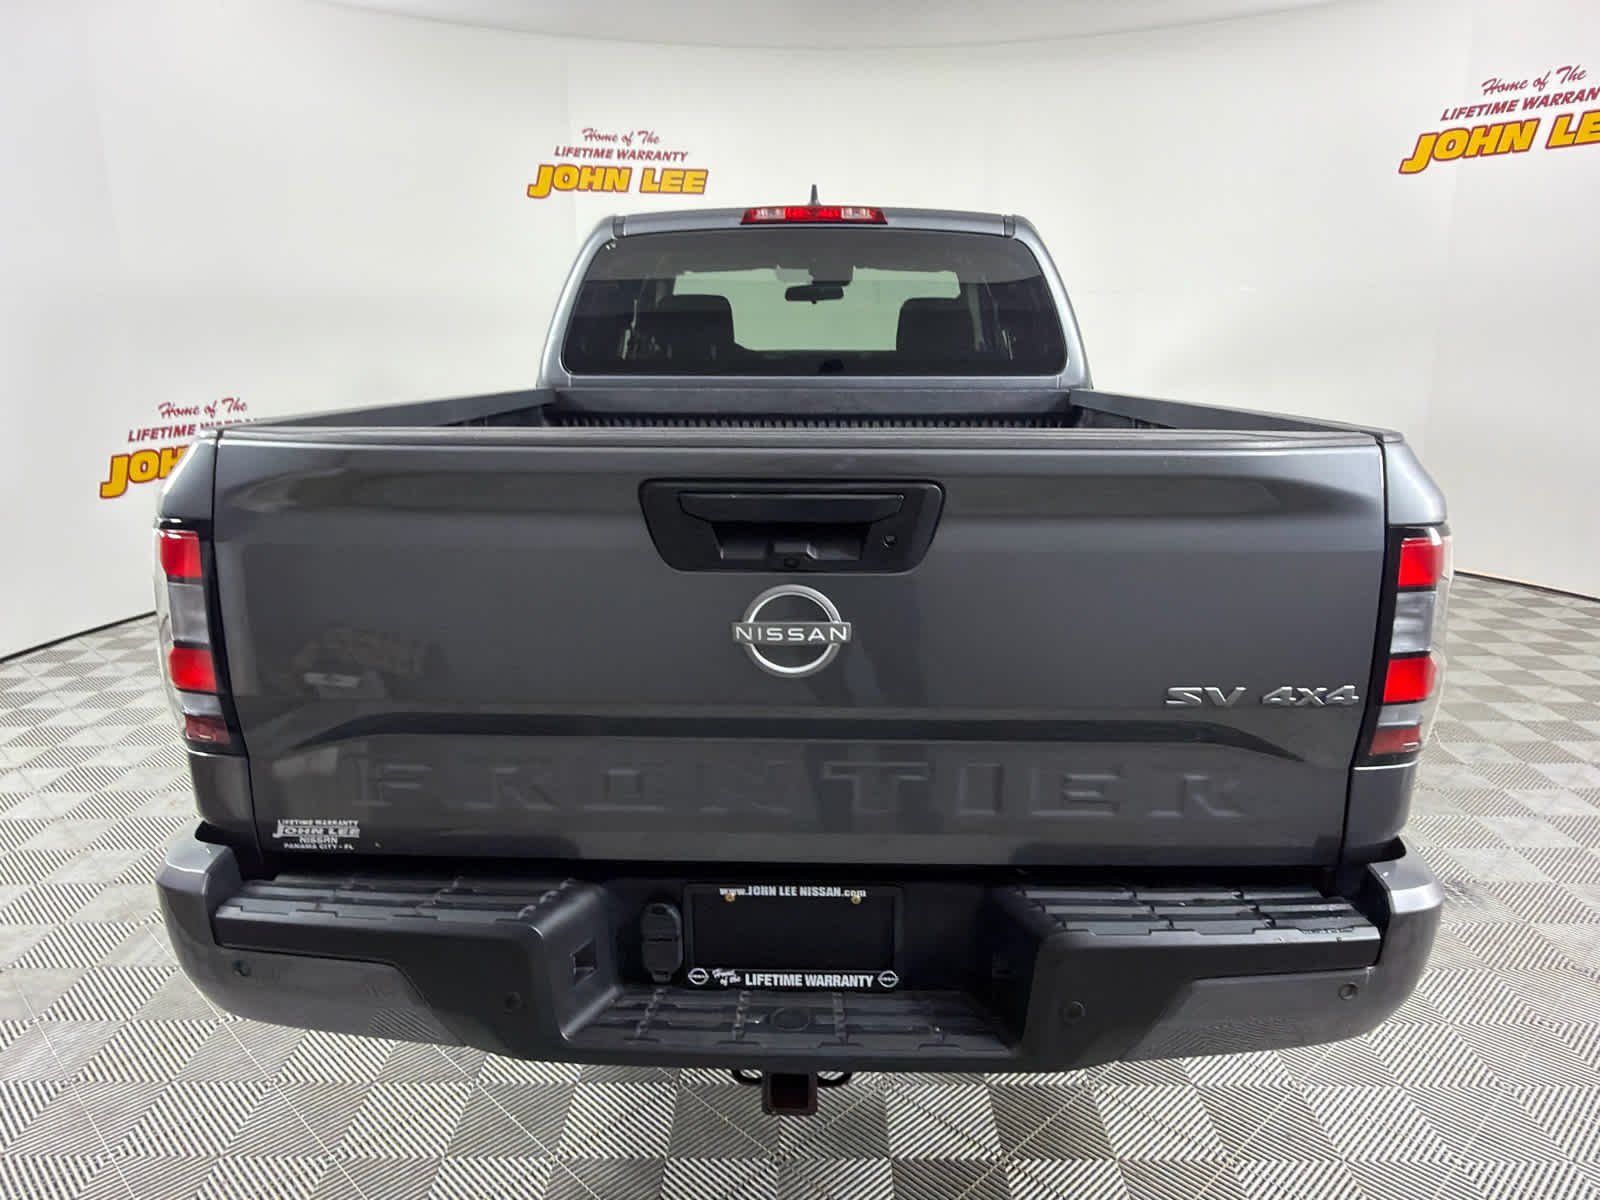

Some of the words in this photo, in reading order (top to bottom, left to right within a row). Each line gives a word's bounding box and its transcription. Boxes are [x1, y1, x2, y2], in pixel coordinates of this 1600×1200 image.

[1481, 77, 1528, 96] Home
[1532, 70, 1552, 92] of
[1556, 64, 1587, 84] The
[1440, 99, 1519, 121] LIFETIME
[1522, 87, 1600, 111] WARRAN
[582, 128, 618, 142] Home
[621, 131, 634, 144] of
[637, 130, 661, 144] The
[1398, 118, 1541, 174] JOHN
[1545, 109, 1600, 149] LE
[554, 146, 613, 159] LIFETIME
[616, 150, 688, 162] WARRANTY
[527, 164, 632, 199] JOHN
[639, 168, 709, 194] LEE
[158, 402, 200, 418] Home
[204, 400, 218, 417] of
[222, 397, 247, 413] The
[128, 424, 196, 442] LIFETIME
[100, 444, 189, 499] JOH
[735, 626, 847, 642] NISSAN
[1165, 686, 1247, 705] SV
[355, 760, 1248, 818] FRONTIER
[272, 825, 324, 838] JOHN
[328, 826, 360, 838] LEE
[779, 886, 798, 897] LEE
[745, 973, 802, 987] LIFETIME
[805, 974, 874, 988] WARRANTY
